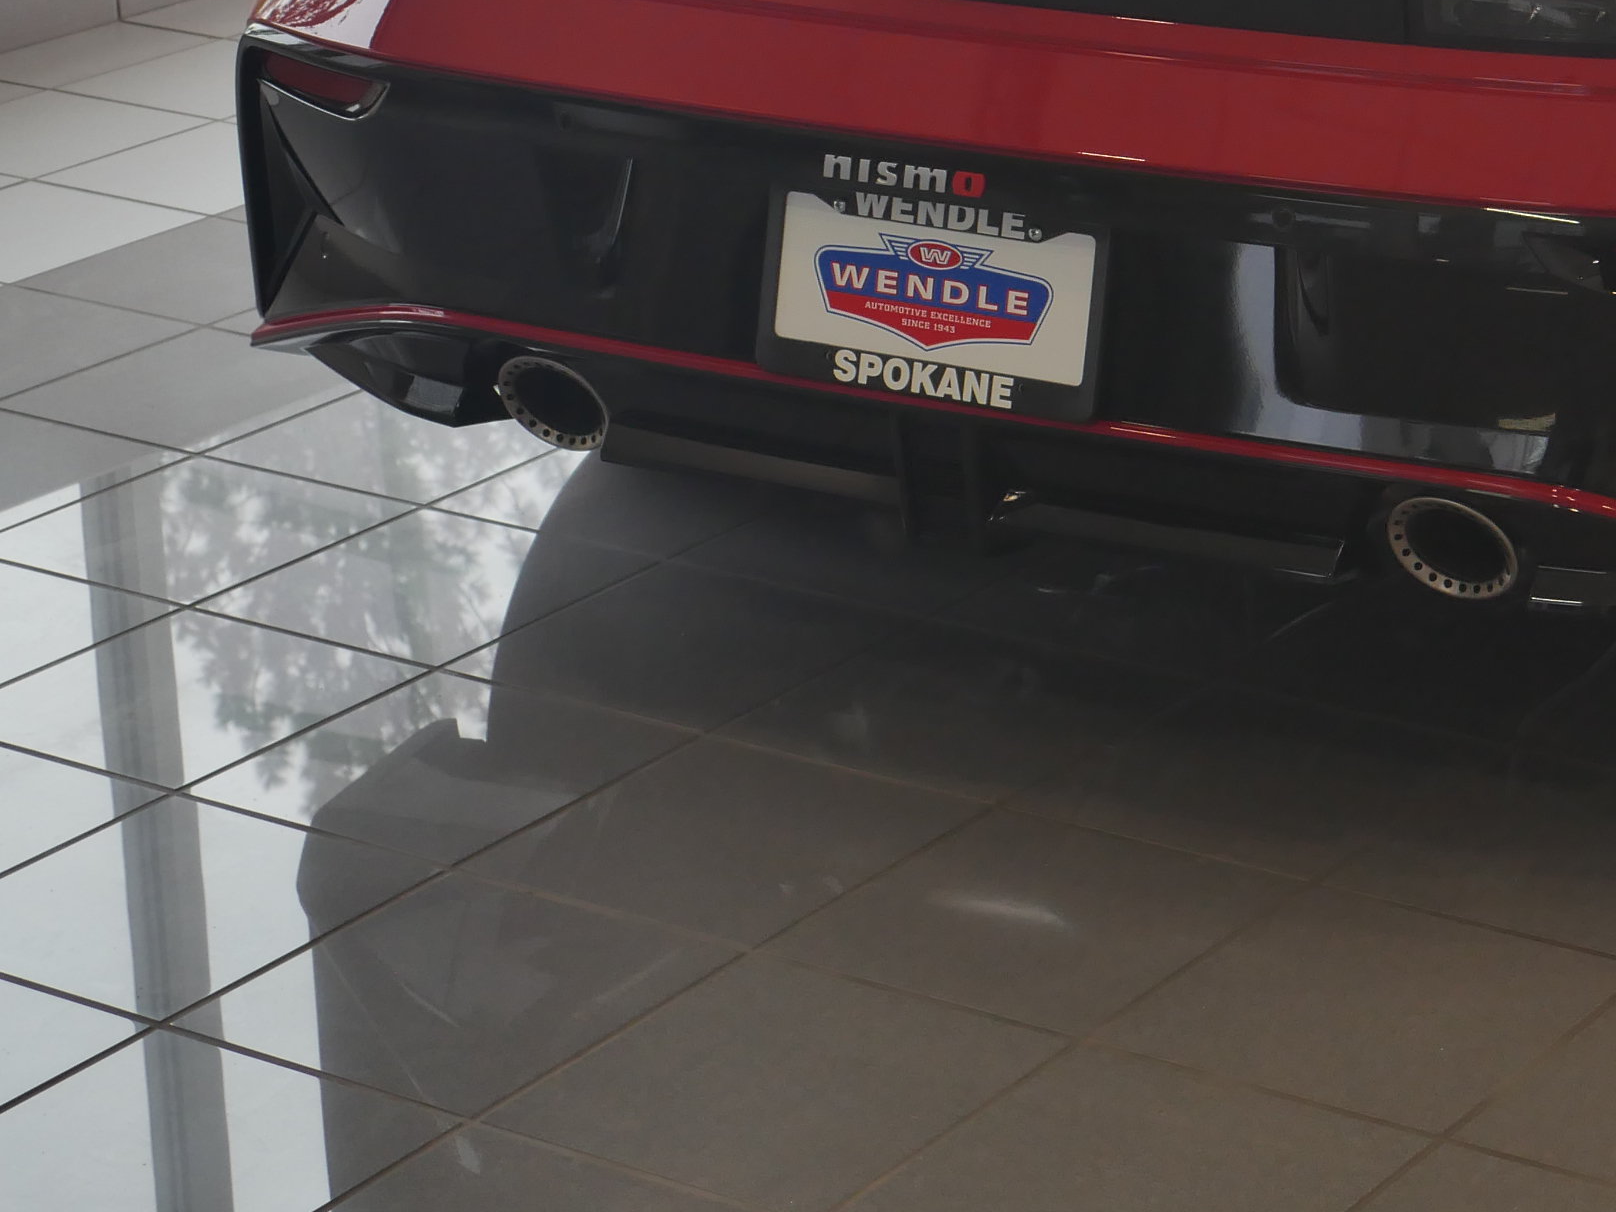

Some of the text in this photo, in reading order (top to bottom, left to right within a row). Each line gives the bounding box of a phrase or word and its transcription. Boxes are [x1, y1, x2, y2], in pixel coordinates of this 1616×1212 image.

[823, 154, 986, 197] nismo
[855, 191, 1027, 240] WENDLE
[830, 261, 1030, 316] WENDLE
[864, 301, 992, 329] AUTOMOTIVE EXCELLENCE
[901, 318, 956, 334] SINCE 1943
[833, 349, 1015, 410] SPOKANE
